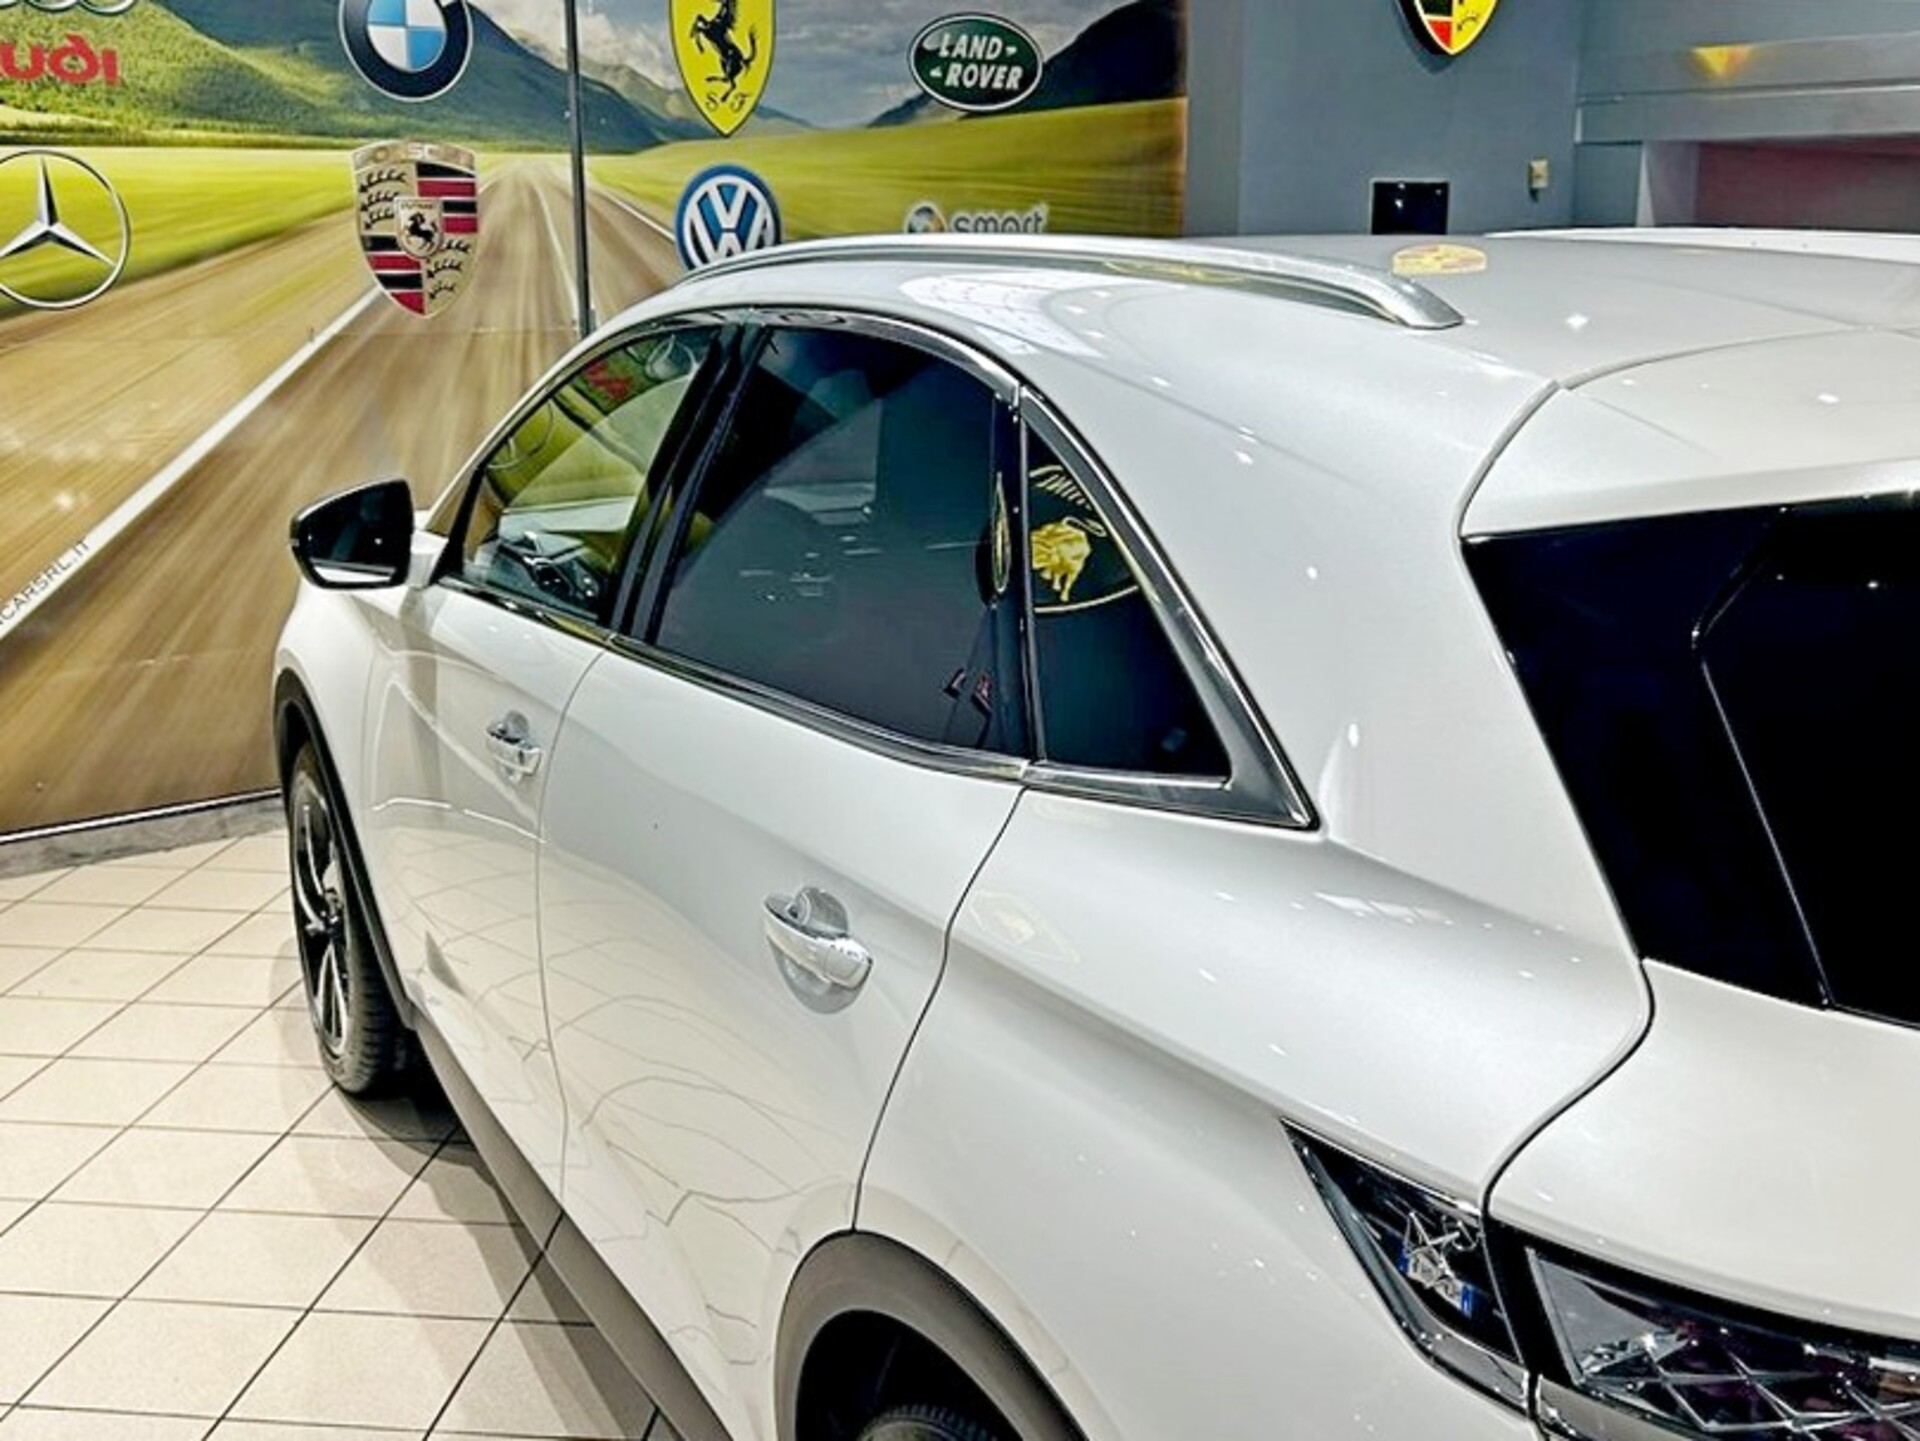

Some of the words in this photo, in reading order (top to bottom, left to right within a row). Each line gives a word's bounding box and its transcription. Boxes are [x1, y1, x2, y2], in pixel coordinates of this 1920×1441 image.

[939, 33, 1003, 60] LAND
[944, 63, 1023, 90] ROVER
[0, 536, 90, 625] CARSRL.IT
